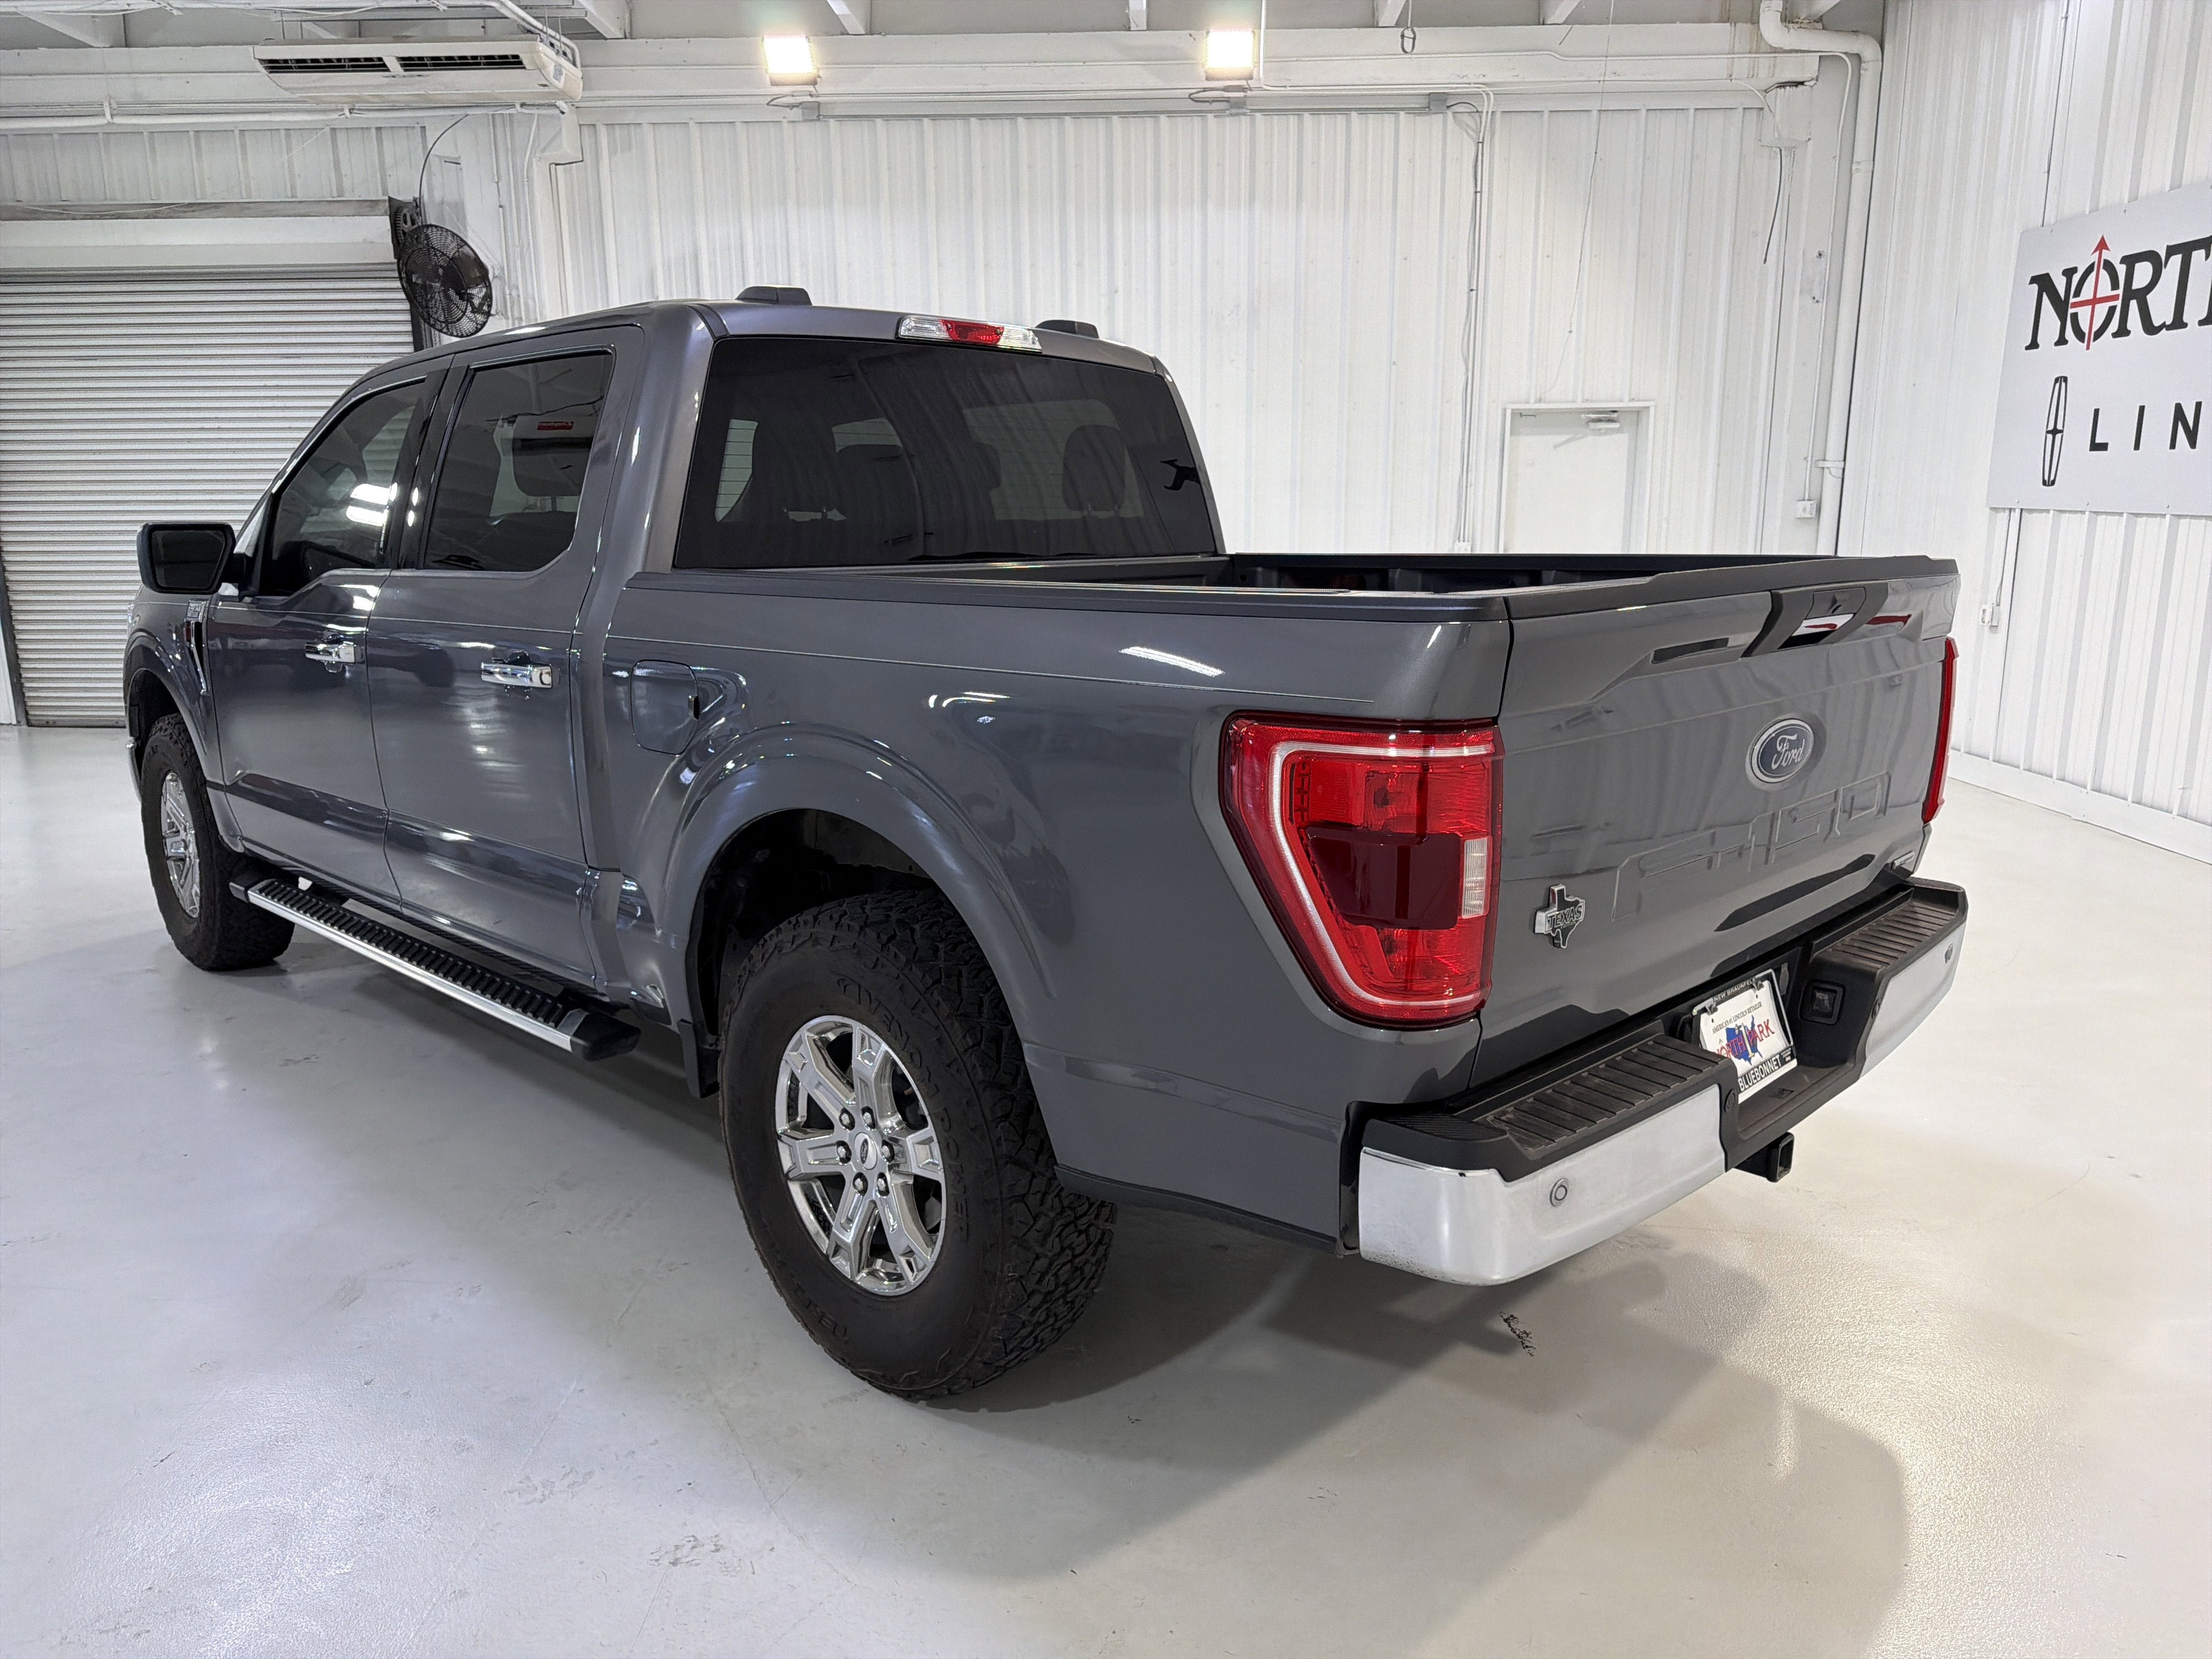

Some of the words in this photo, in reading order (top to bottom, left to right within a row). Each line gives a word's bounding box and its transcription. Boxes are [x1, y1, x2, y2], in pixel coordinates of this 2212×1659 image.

[1771, 733, 1805, 770] Ford
[1611, 771, 1892, 922] F-150
[1547, 904, 1582, 929] TEXAS
[1714, 992, 1726, 1002] NEW
[1726, 977, 1756, 996] BRAUNFELS
[1733, 1009, 1748, 1023] LINCOLN
[1747, 1001, 1763, 1014] RETAILER
[1747, 1019, 1775, 1047] PARK
[1738, 1054, 1781, 1092] BLUEBONNET
